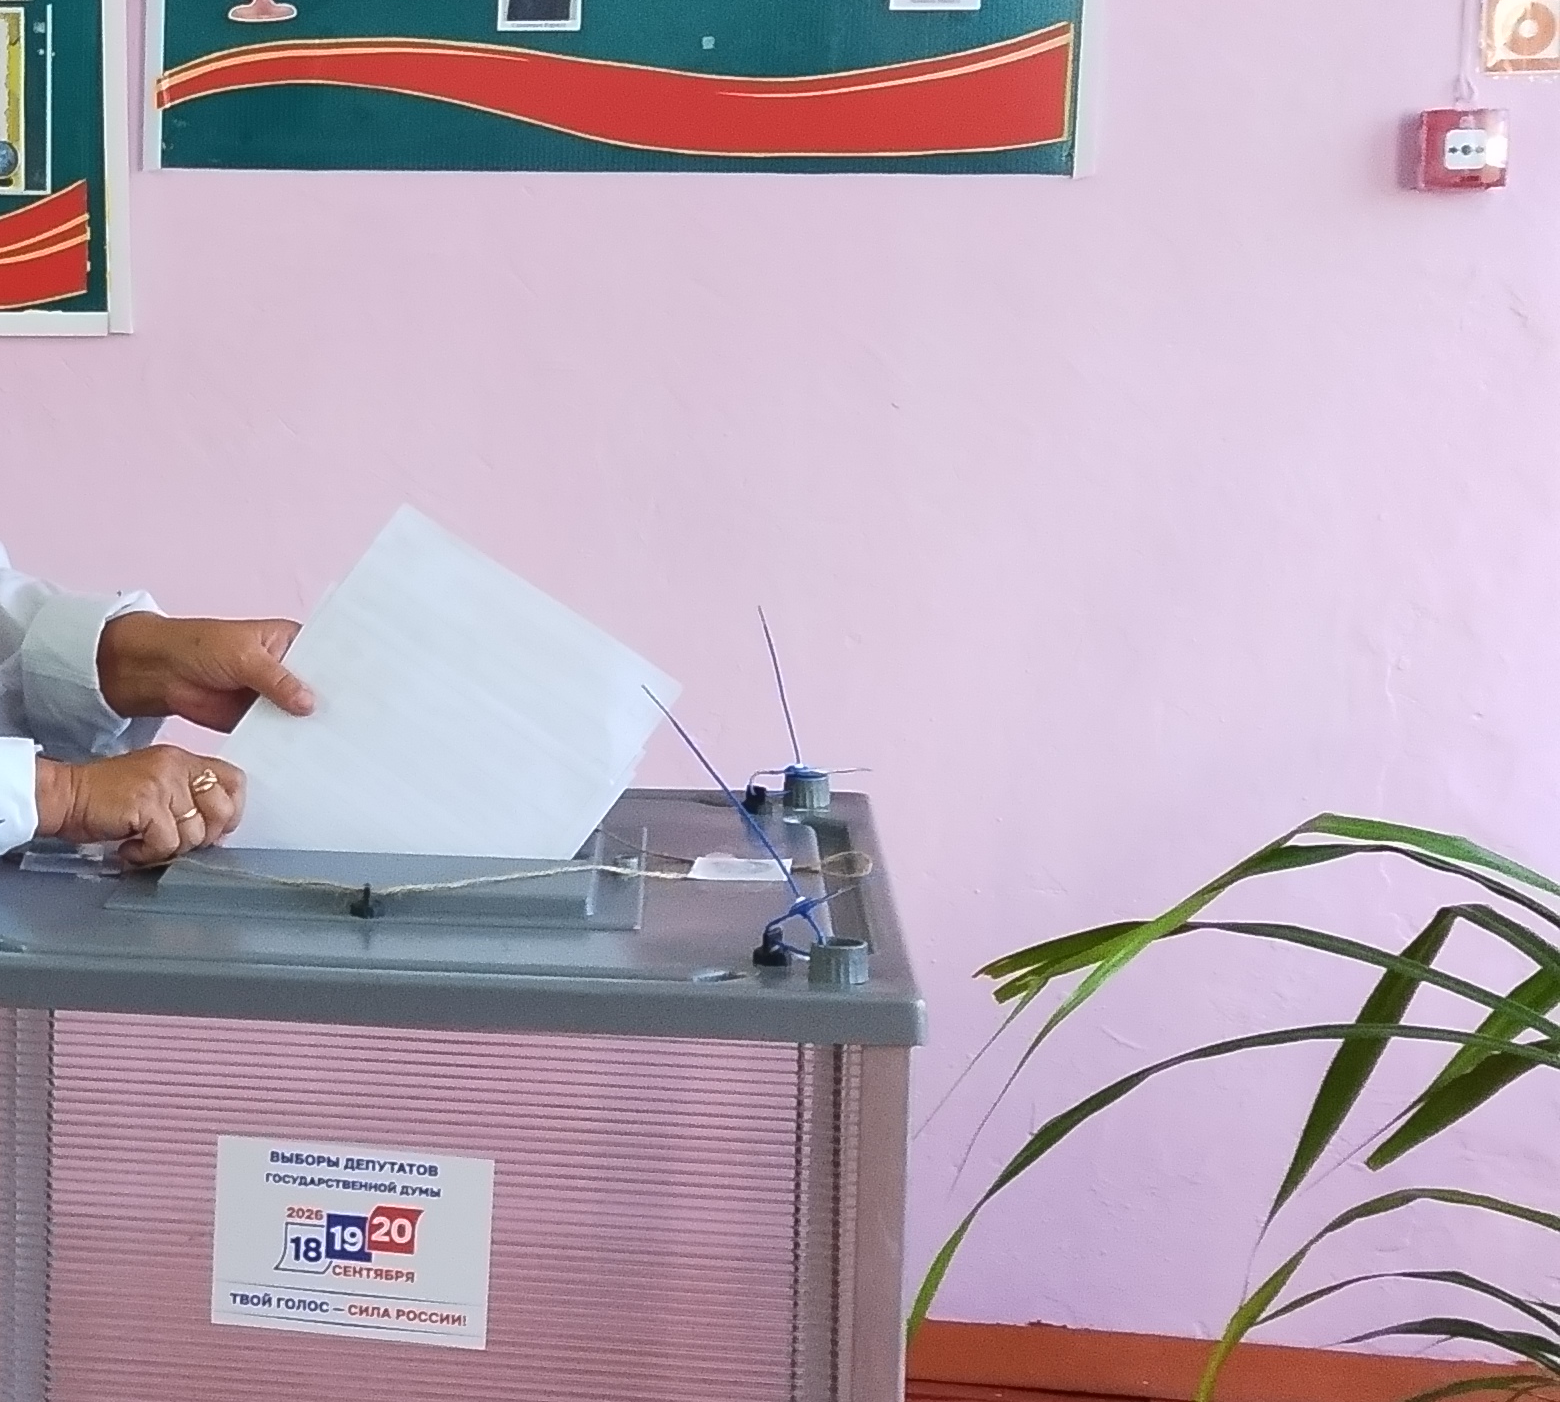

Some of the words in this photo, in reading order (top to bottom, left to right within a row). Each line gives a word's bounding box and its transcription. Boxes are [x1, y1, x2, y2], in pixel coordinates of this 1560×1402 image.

[269, 1150, 340, 1170] ВЫБОРЫ
[343, 1157, 439, 1178] ДЕПУТАТОВ
[265, 1172, 397, 1195] ГОСУДАРСТВЕННОЙ
[399, 1183, 442, 1199] ДУМЫ
[285, 1206, 324, 1222] 2026
[289, 1235, 323, 1264] 18
[329, 1225, 363, 1253] 19
[370, 1216, 413, 1245] 20
[331, 1264, 416, 1284] СЕНТЯБРЯ
[229, 1292, 272, 1309] ТВОЙ
[276, 1296, 330, 1313] ГОЛОС
[347, 1303, 393, 1320] СИЛА
[395, 1308, 468, 1328] РОССИИ!
